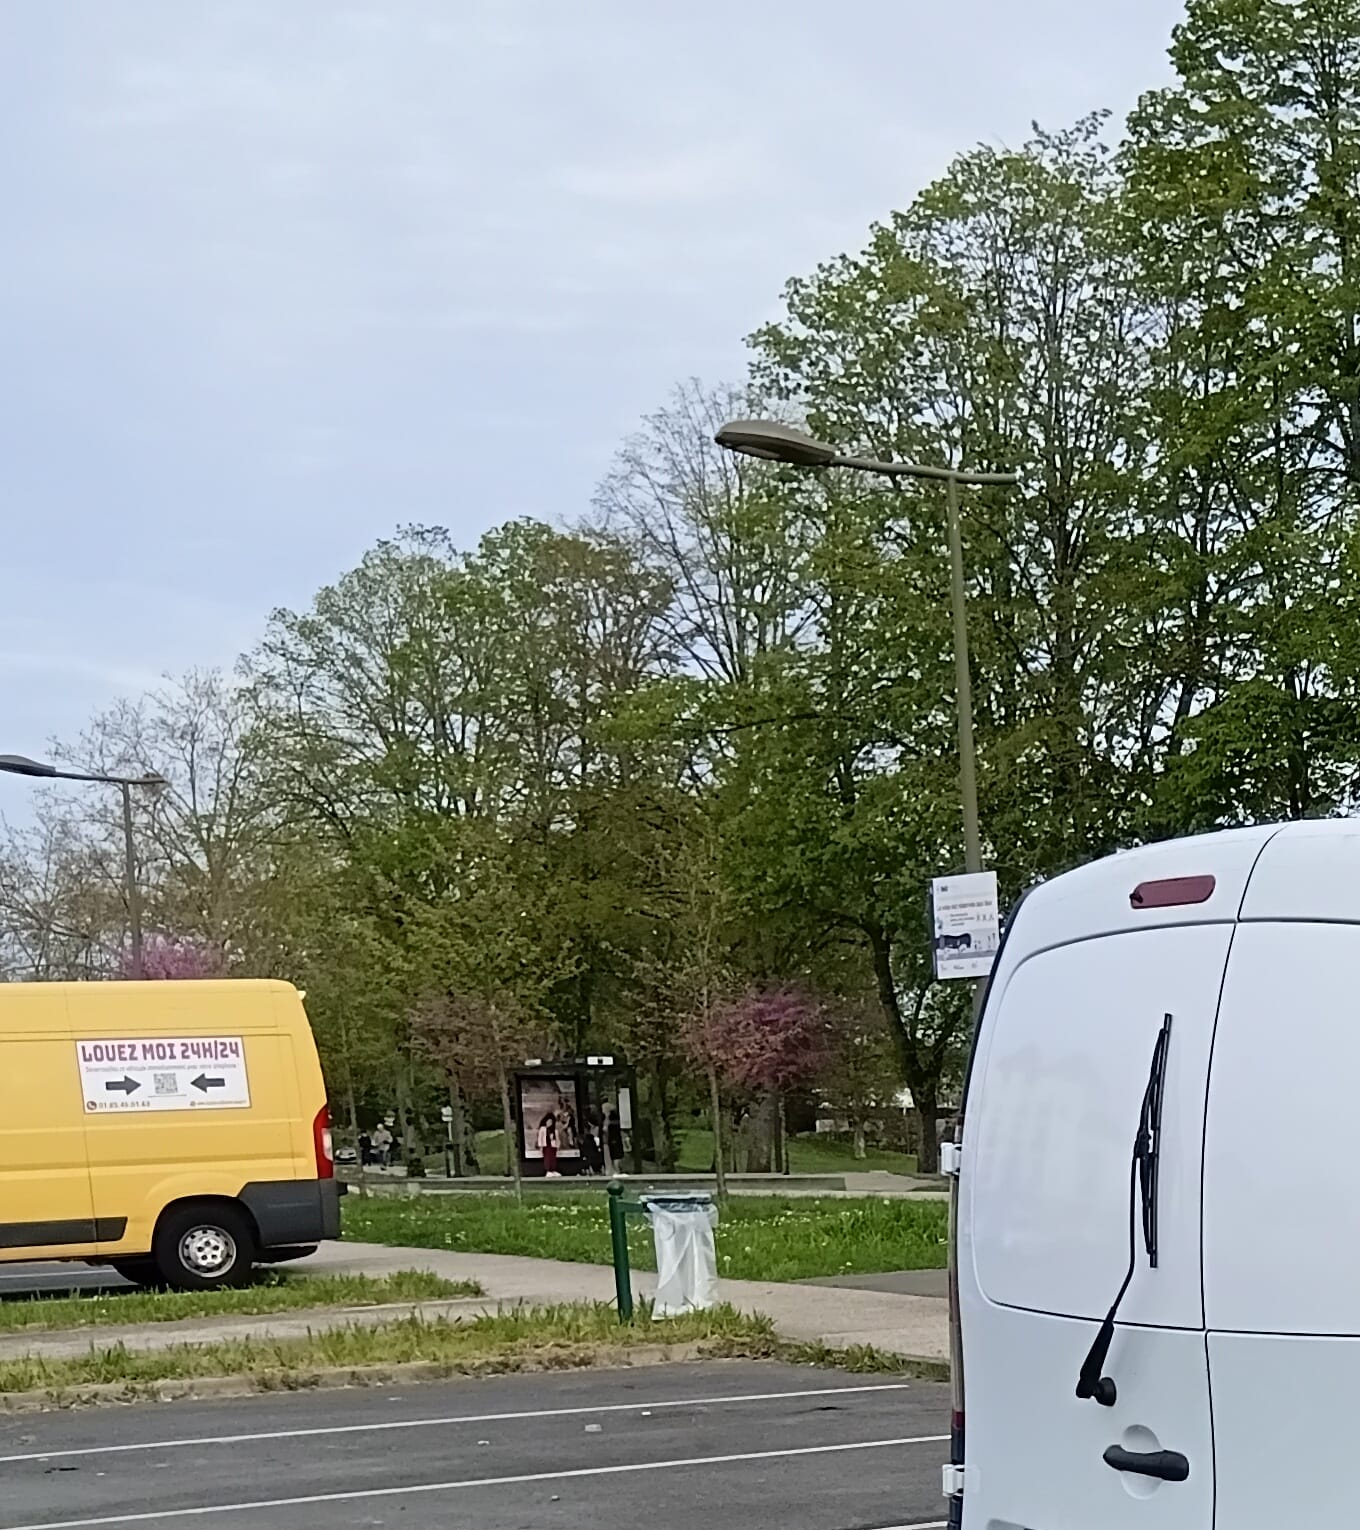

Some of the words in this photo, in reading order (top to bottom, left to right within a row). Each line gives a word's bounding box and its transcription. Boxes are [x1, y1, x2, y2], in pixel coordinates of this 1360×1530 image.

[81, 1044, 138, 1062] LOUEZ
[142, 1042, 176, 1061] MOI
[181, 1040, 240, 1060] 24H/24
